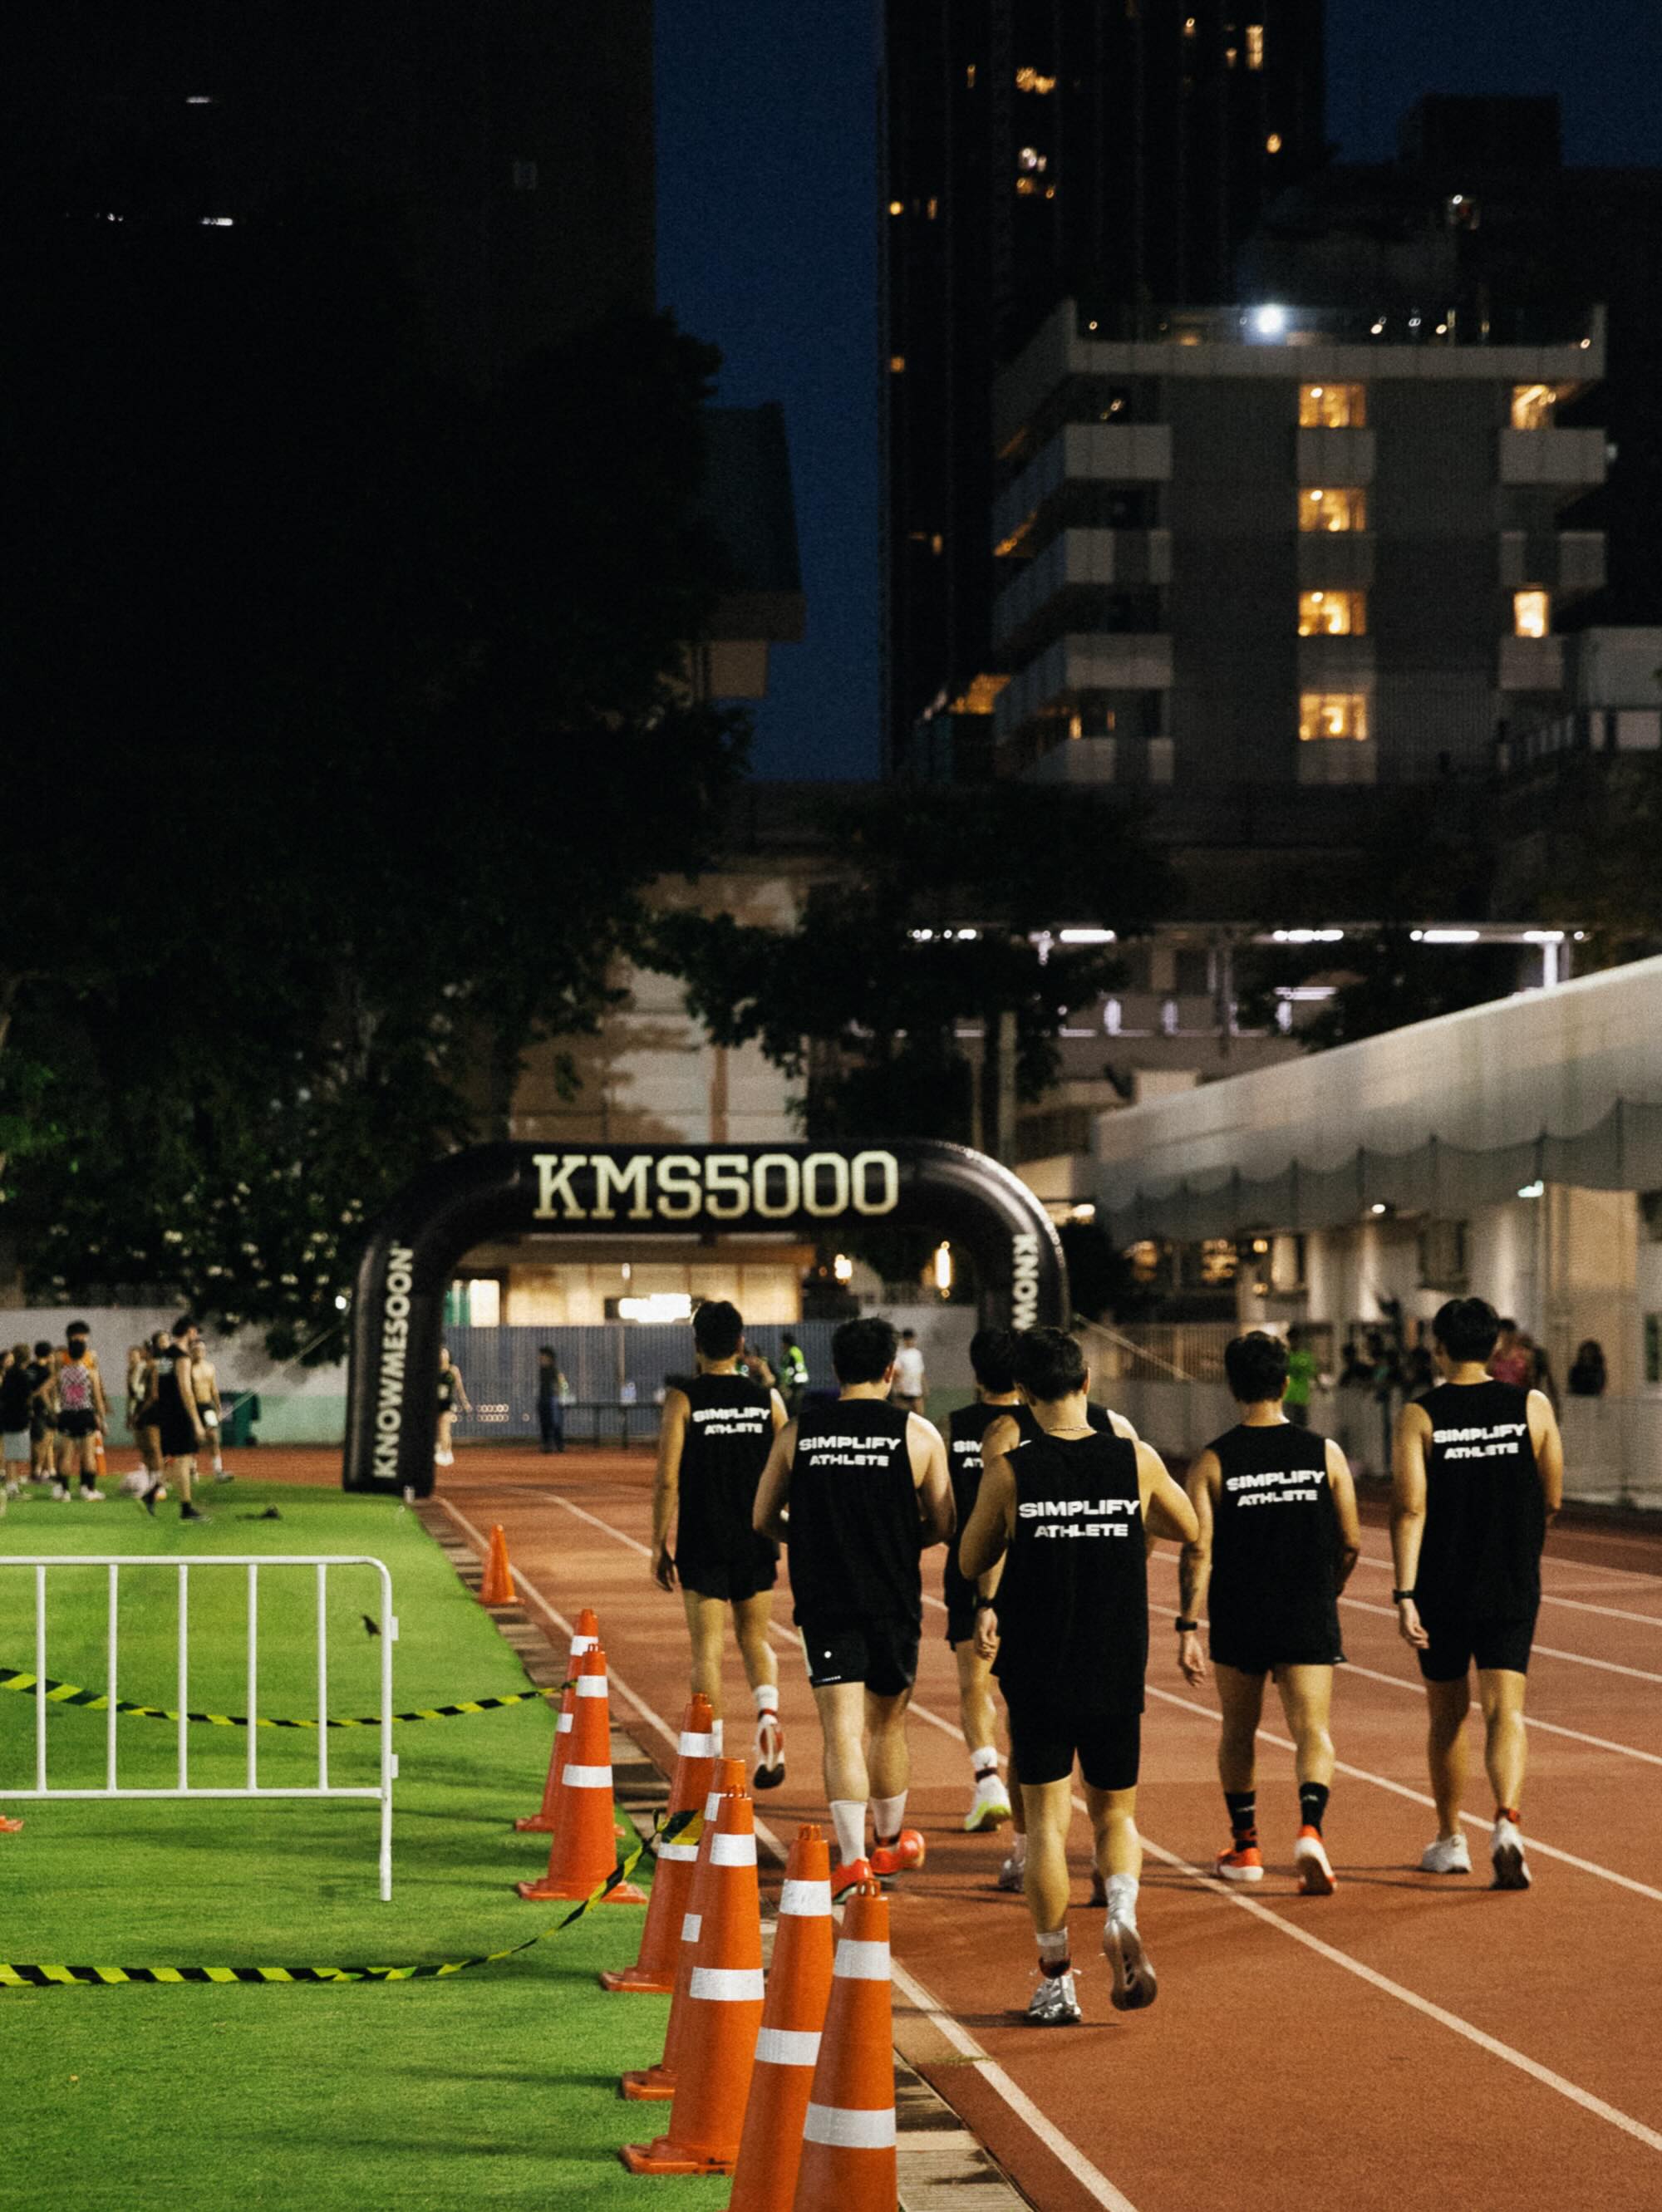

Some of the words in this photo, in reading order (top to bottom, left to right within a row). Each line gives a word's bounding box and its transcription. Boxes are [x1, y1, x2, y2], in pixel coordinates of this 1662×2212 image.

[533, 1150, 898, 1219] KMS5000
[373, 1247, 413, 1477] KNOWMESOON
[692, 1407, 770, 1423] SIMPLIFY
[704, 1422, 763, 1435] ATHLETE
[1433, 1423, 1527, 1444] SIMPLIFY
[799, 1436, 901, 1451] SIMPLIFY
[1444, 1443, 1518, 1459] ATHLETE
[809, 1454, 889, 1467] ATHLETE
[1226, 1470, 1325, 1492] SIMPLIFY
[1237, 1489, 1318, 1507] ATHLETE
[1019, 1499, 1140, 1518] SIMPLIFY
[1035, 1523, 1128, 1538] ATHLETE
